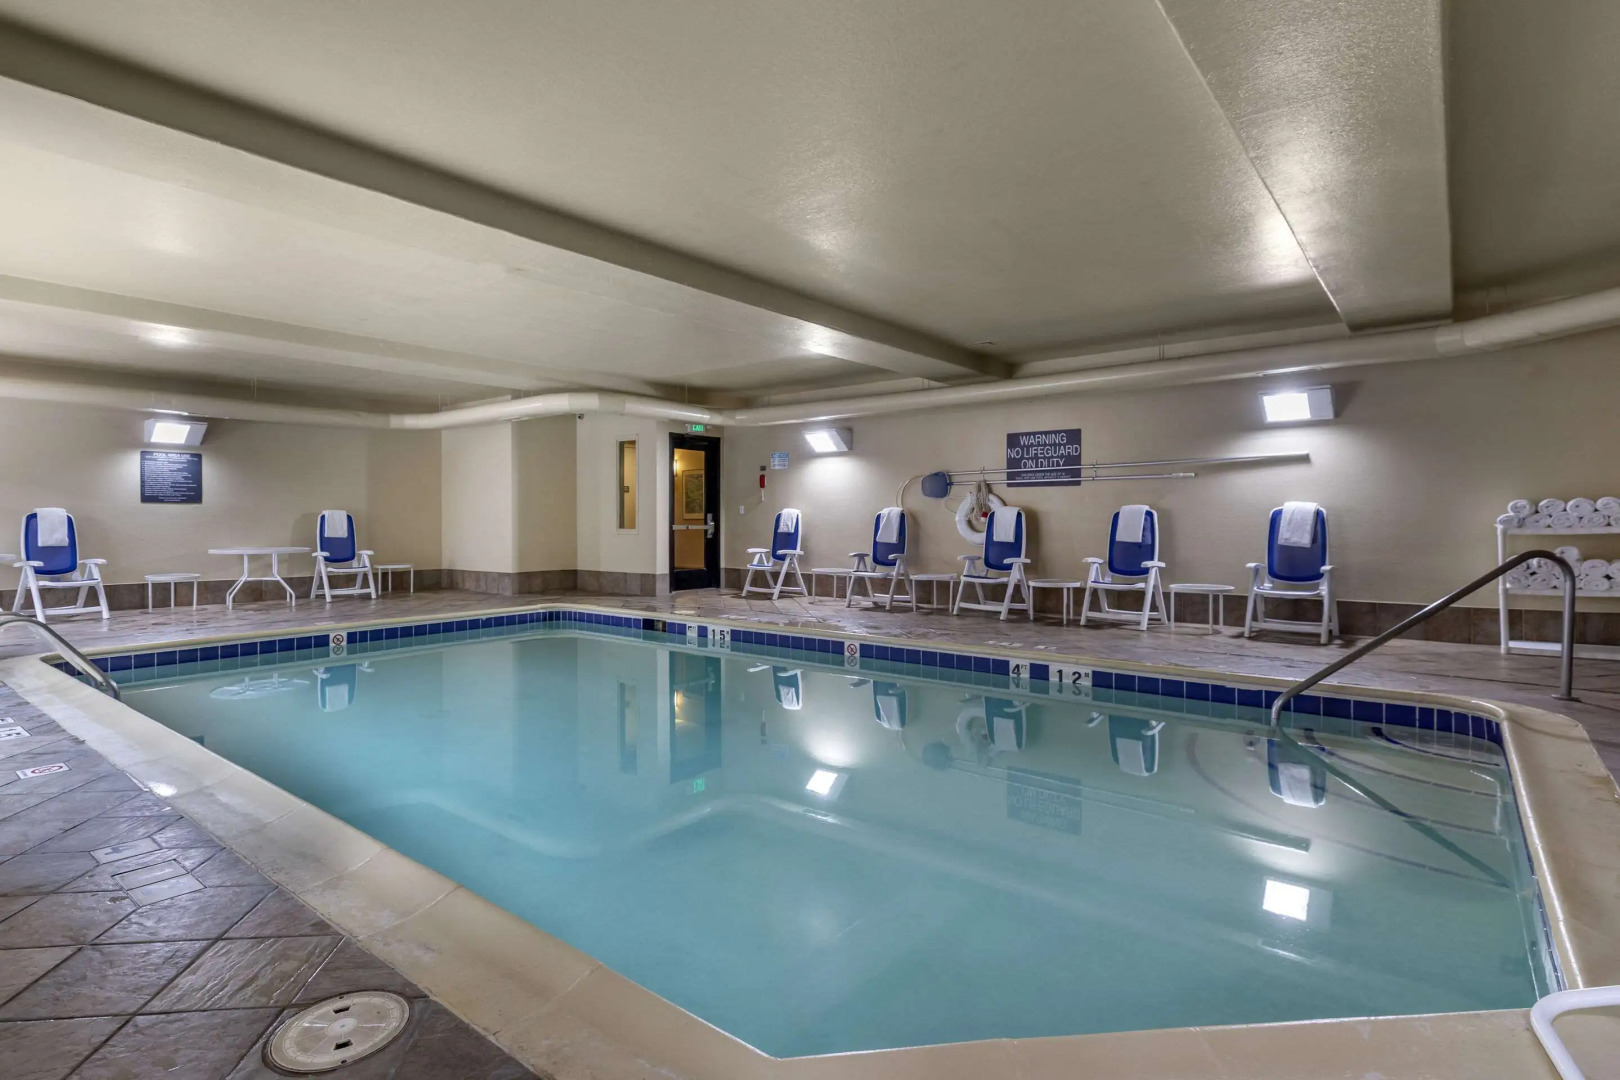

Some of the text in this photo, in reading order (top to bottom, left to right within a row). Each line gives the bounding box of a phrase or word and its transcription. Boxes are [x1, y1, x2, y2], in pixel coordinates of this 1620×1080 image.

[1019, 433, 1067, 446] WARNING
[1007, 445, 1081, 459] NO LIFEGUARD
[1021, 458, 1065, 469] ON DUTY
